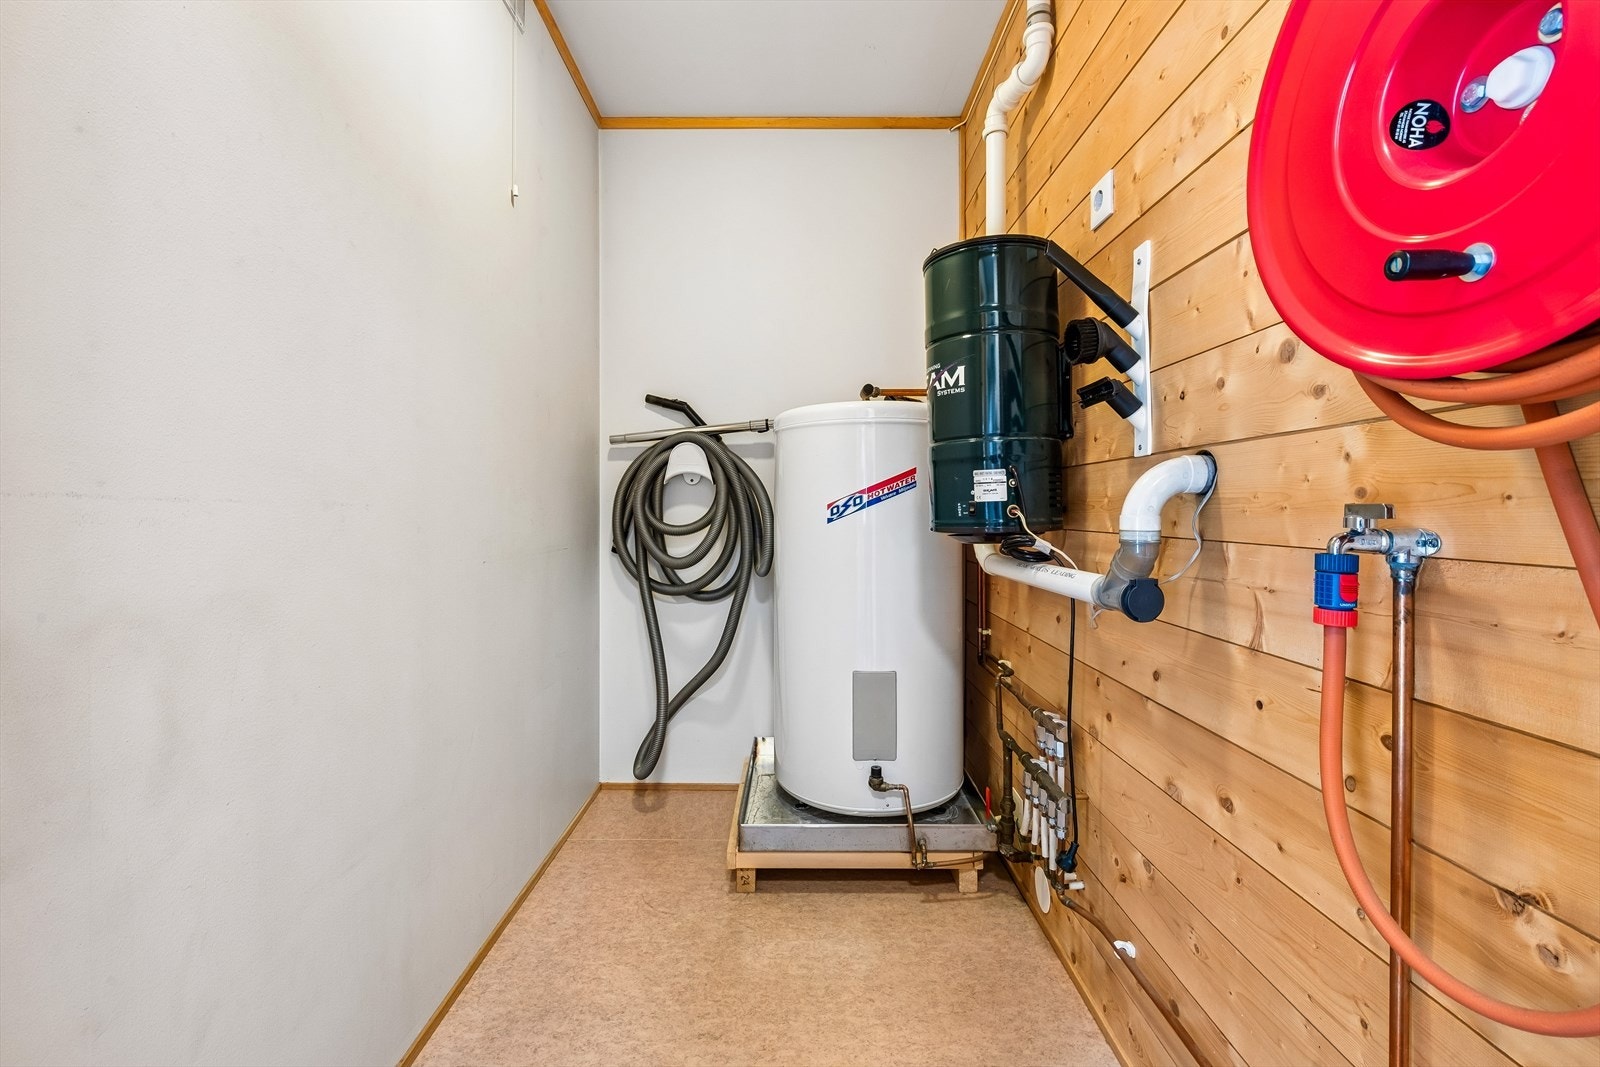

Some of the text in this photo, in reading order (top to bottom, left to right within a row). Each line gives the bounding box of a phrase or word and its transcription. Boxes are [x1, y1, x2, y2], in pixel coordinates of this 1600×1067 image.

[1408, 102, 1431, 148] NOHA
[927, 365, 966, 390] AM
[937, 386, 966, 397] SYSTEMS
